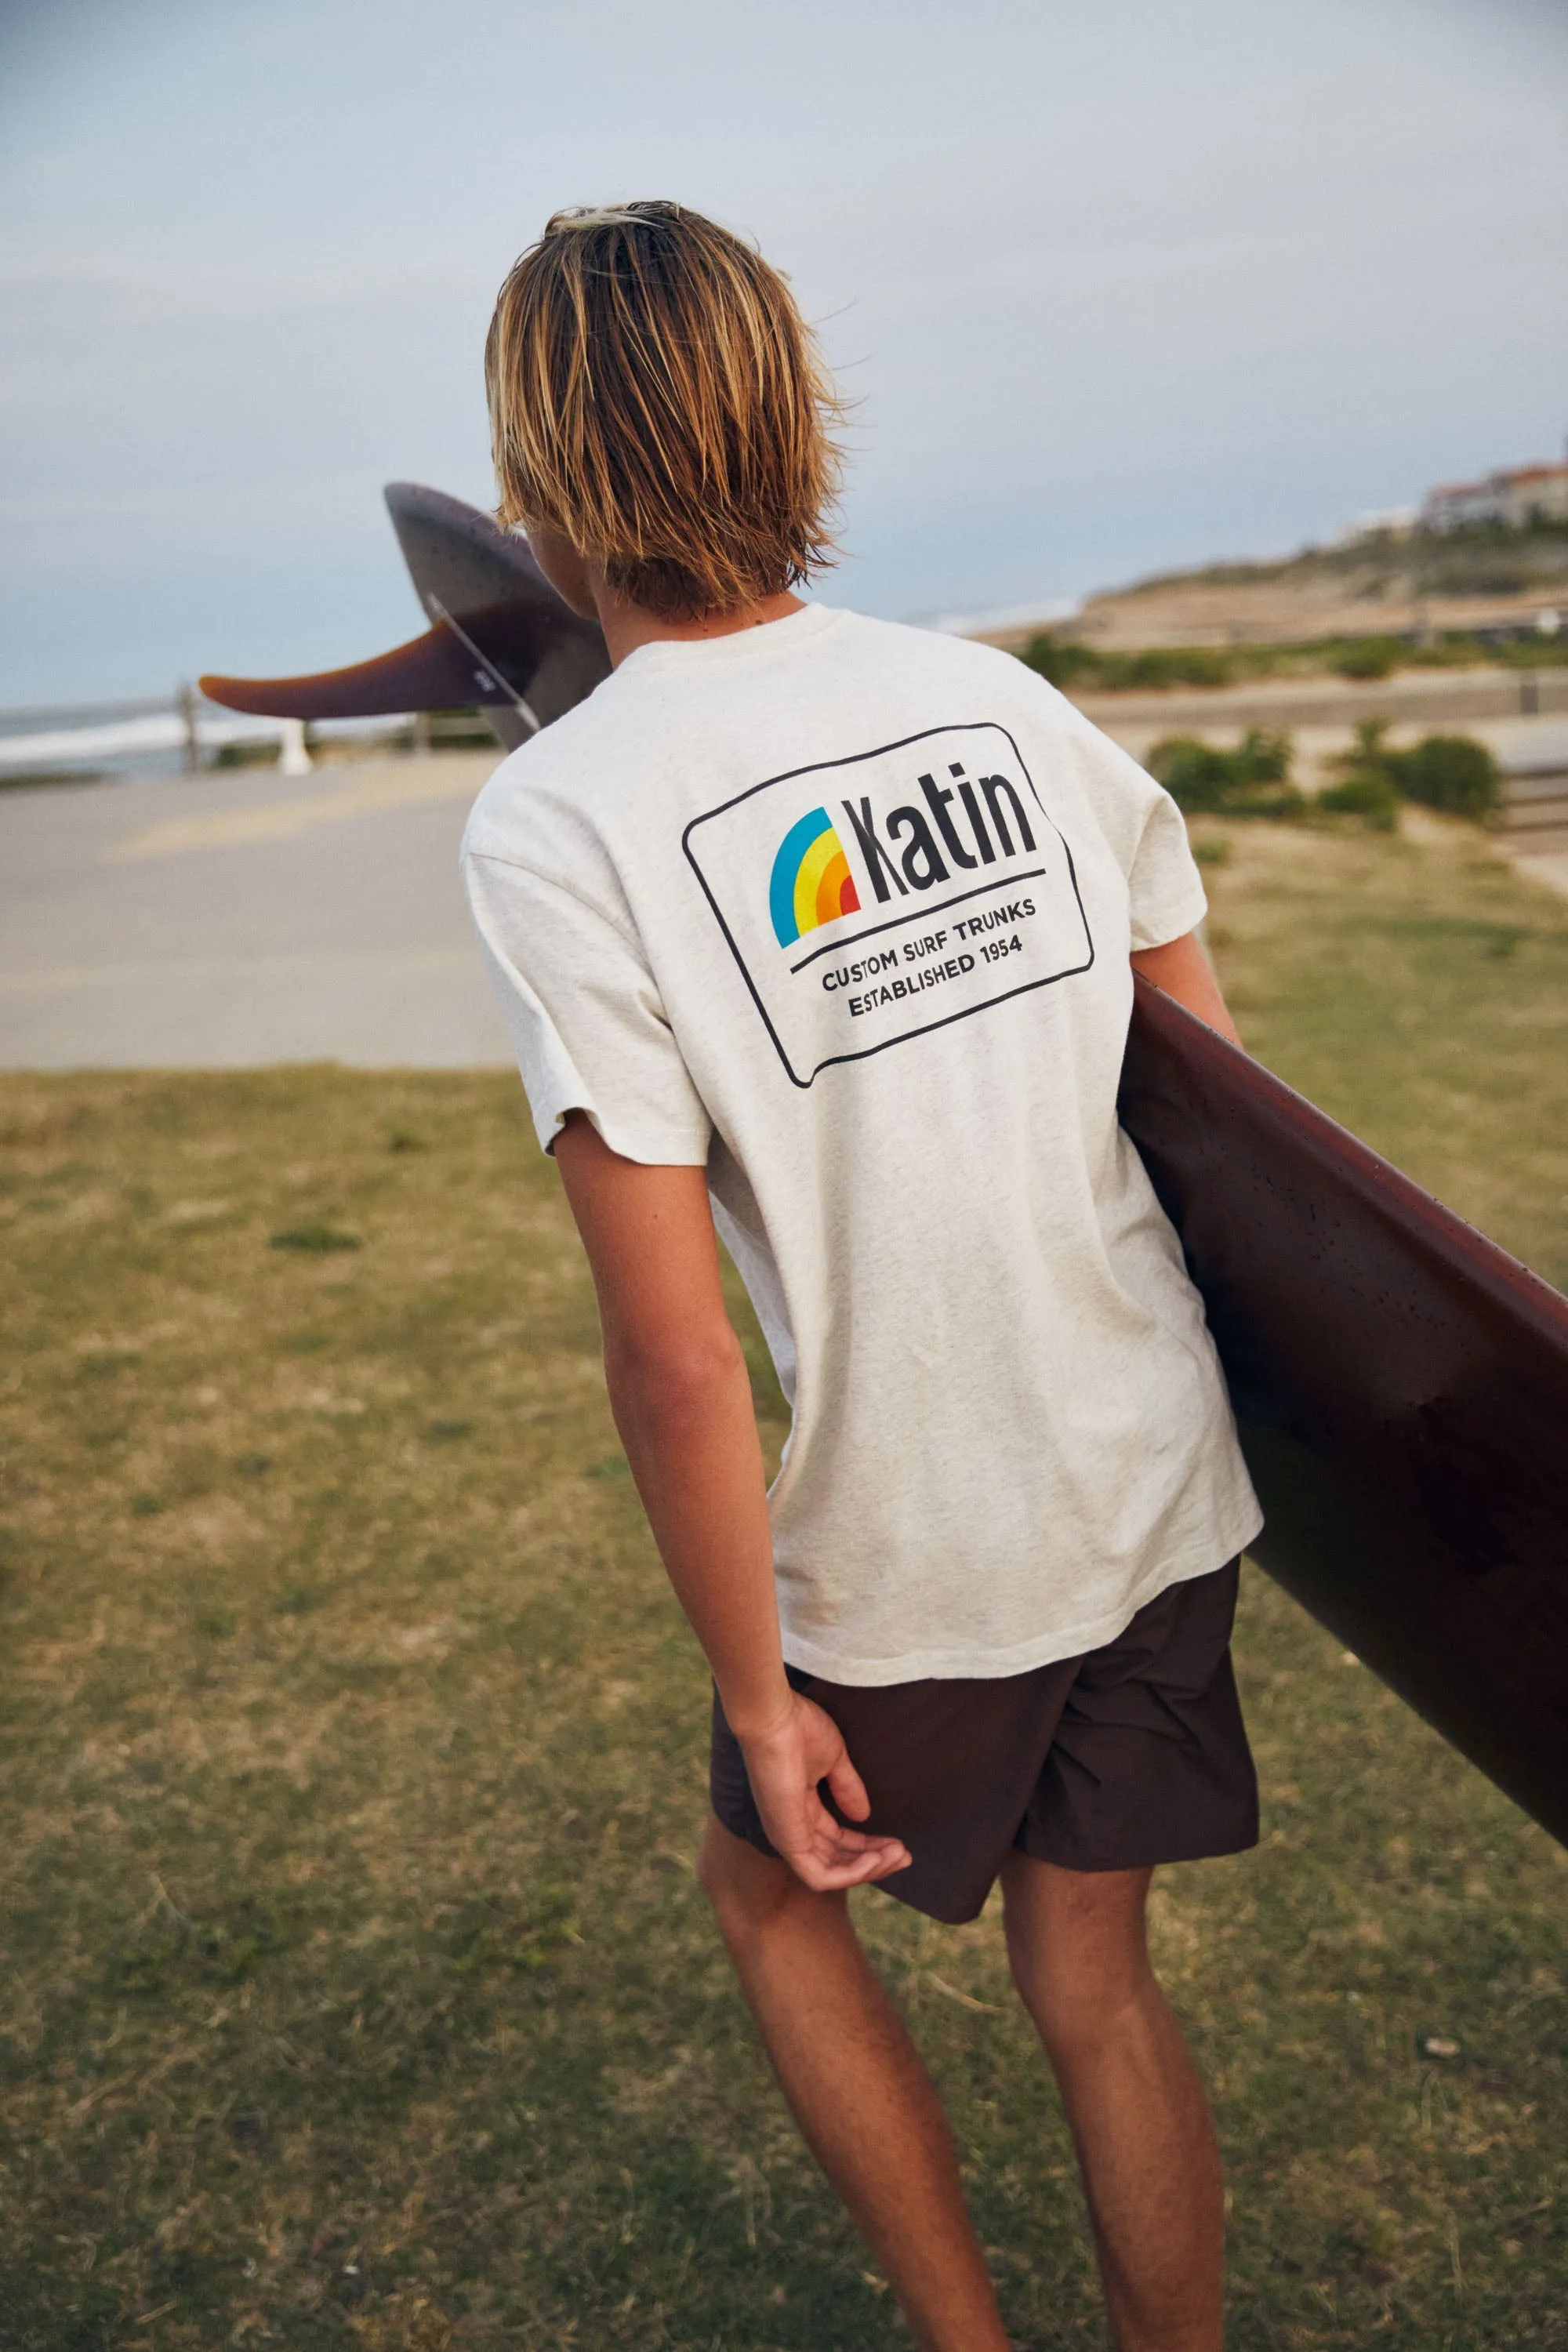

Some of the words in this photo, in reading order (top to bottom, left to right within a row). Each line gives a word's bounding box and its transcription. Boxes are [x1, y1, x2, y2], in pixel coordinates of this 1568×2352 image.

[840, 762, 1037, 904] Katin
[822, 949, 898, 992] CUSTOM
[903, 930, 948, 962] SURF
[953, 898, 1036, 941] TRUNKS
[848, 954, 975, 1018] ESTABLISHED
[979, 934, 1023, 964] 1954
